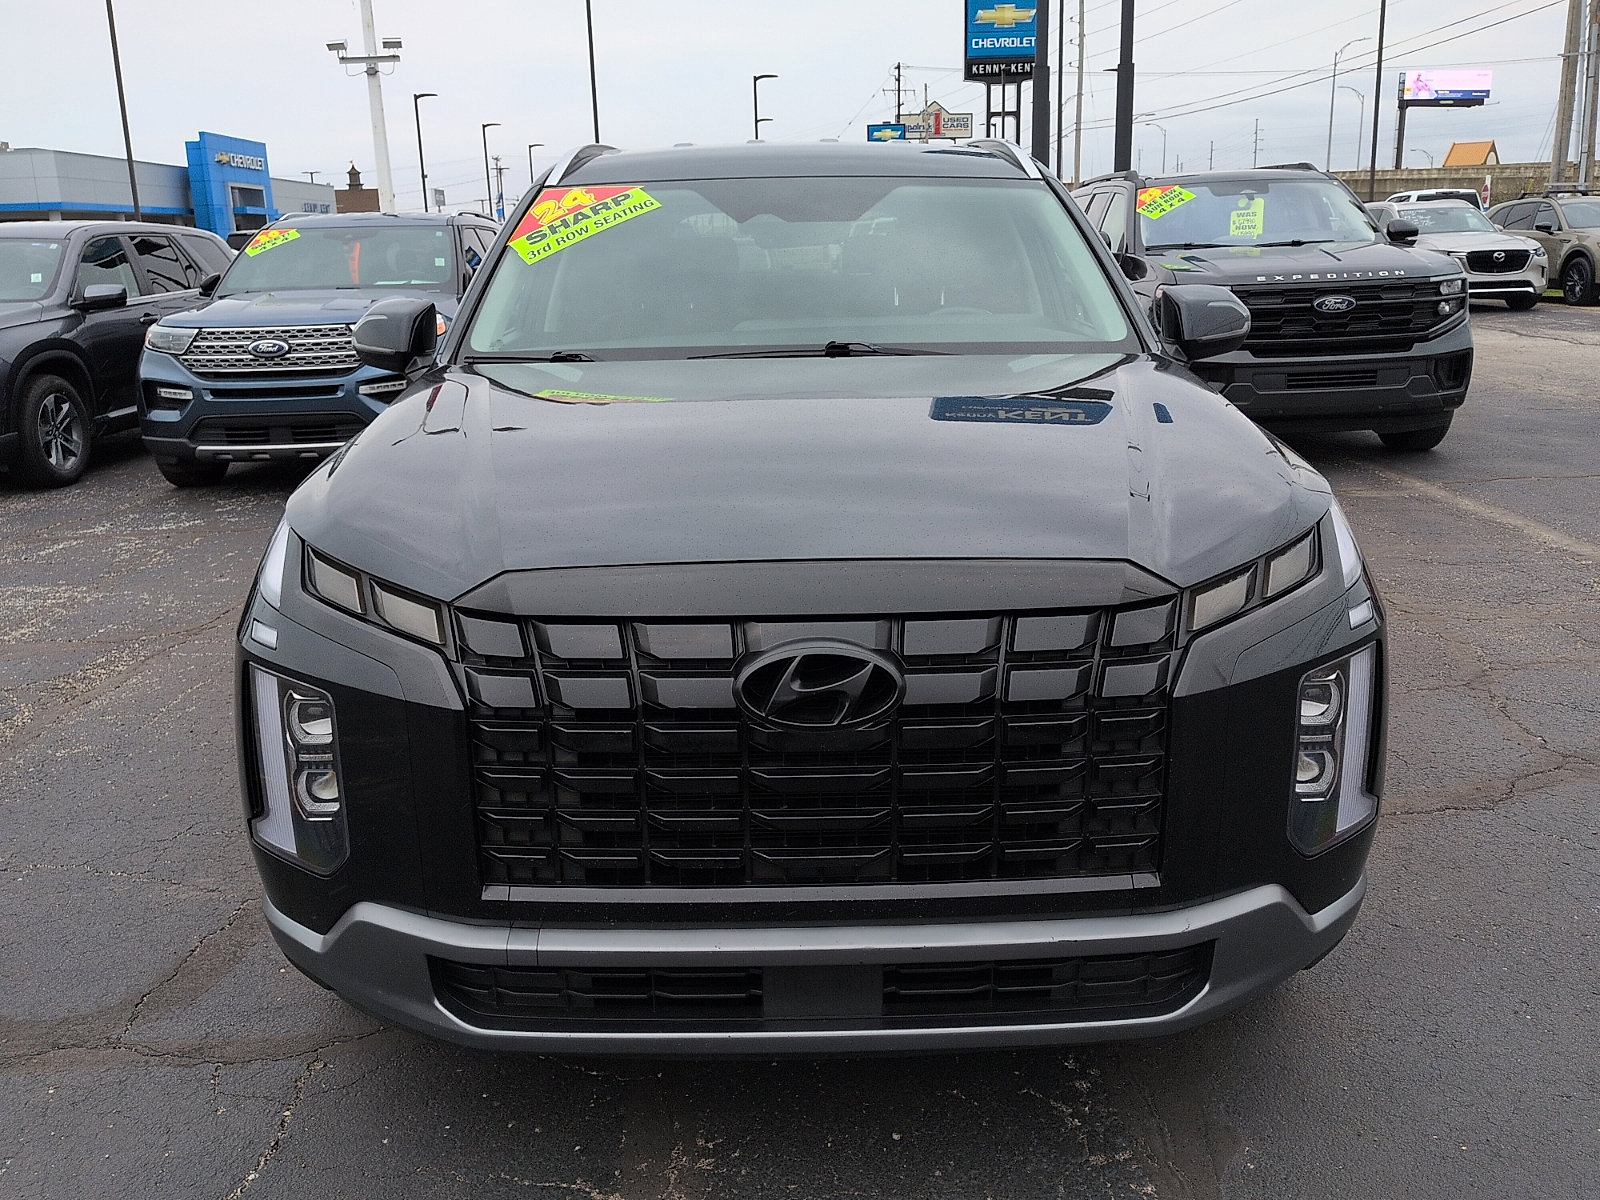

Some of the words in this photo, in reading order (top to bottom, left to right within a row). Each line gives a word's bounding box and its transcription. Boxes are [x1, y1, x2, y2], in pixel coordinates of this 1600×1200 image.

[971, 37, 1036, 48] CHEVROLET
[972, 63, 1005, 74] KENNY
[230, 153, 264, 171] CHEVROLET
[530, 188, 598, 226] 24
[1141, 200, 1159, 211] LIKE
[1159, 188, 1177, 200] NEW
[1146, 202, 1163, 214] SUN
[1163, 191, 1184, 204] ROOF
[525, 192, 633, 246] SHARP
[526, 242, 552, 260] 3rd
[555, 225, 589, 246] ROW
[593, 199, 655, 229] SEATING
[1256, 270, 1405, 282] EXPEDITION
[1322, 298, 1348, 310] Ford
[257, 343, 279, 353] Ford
